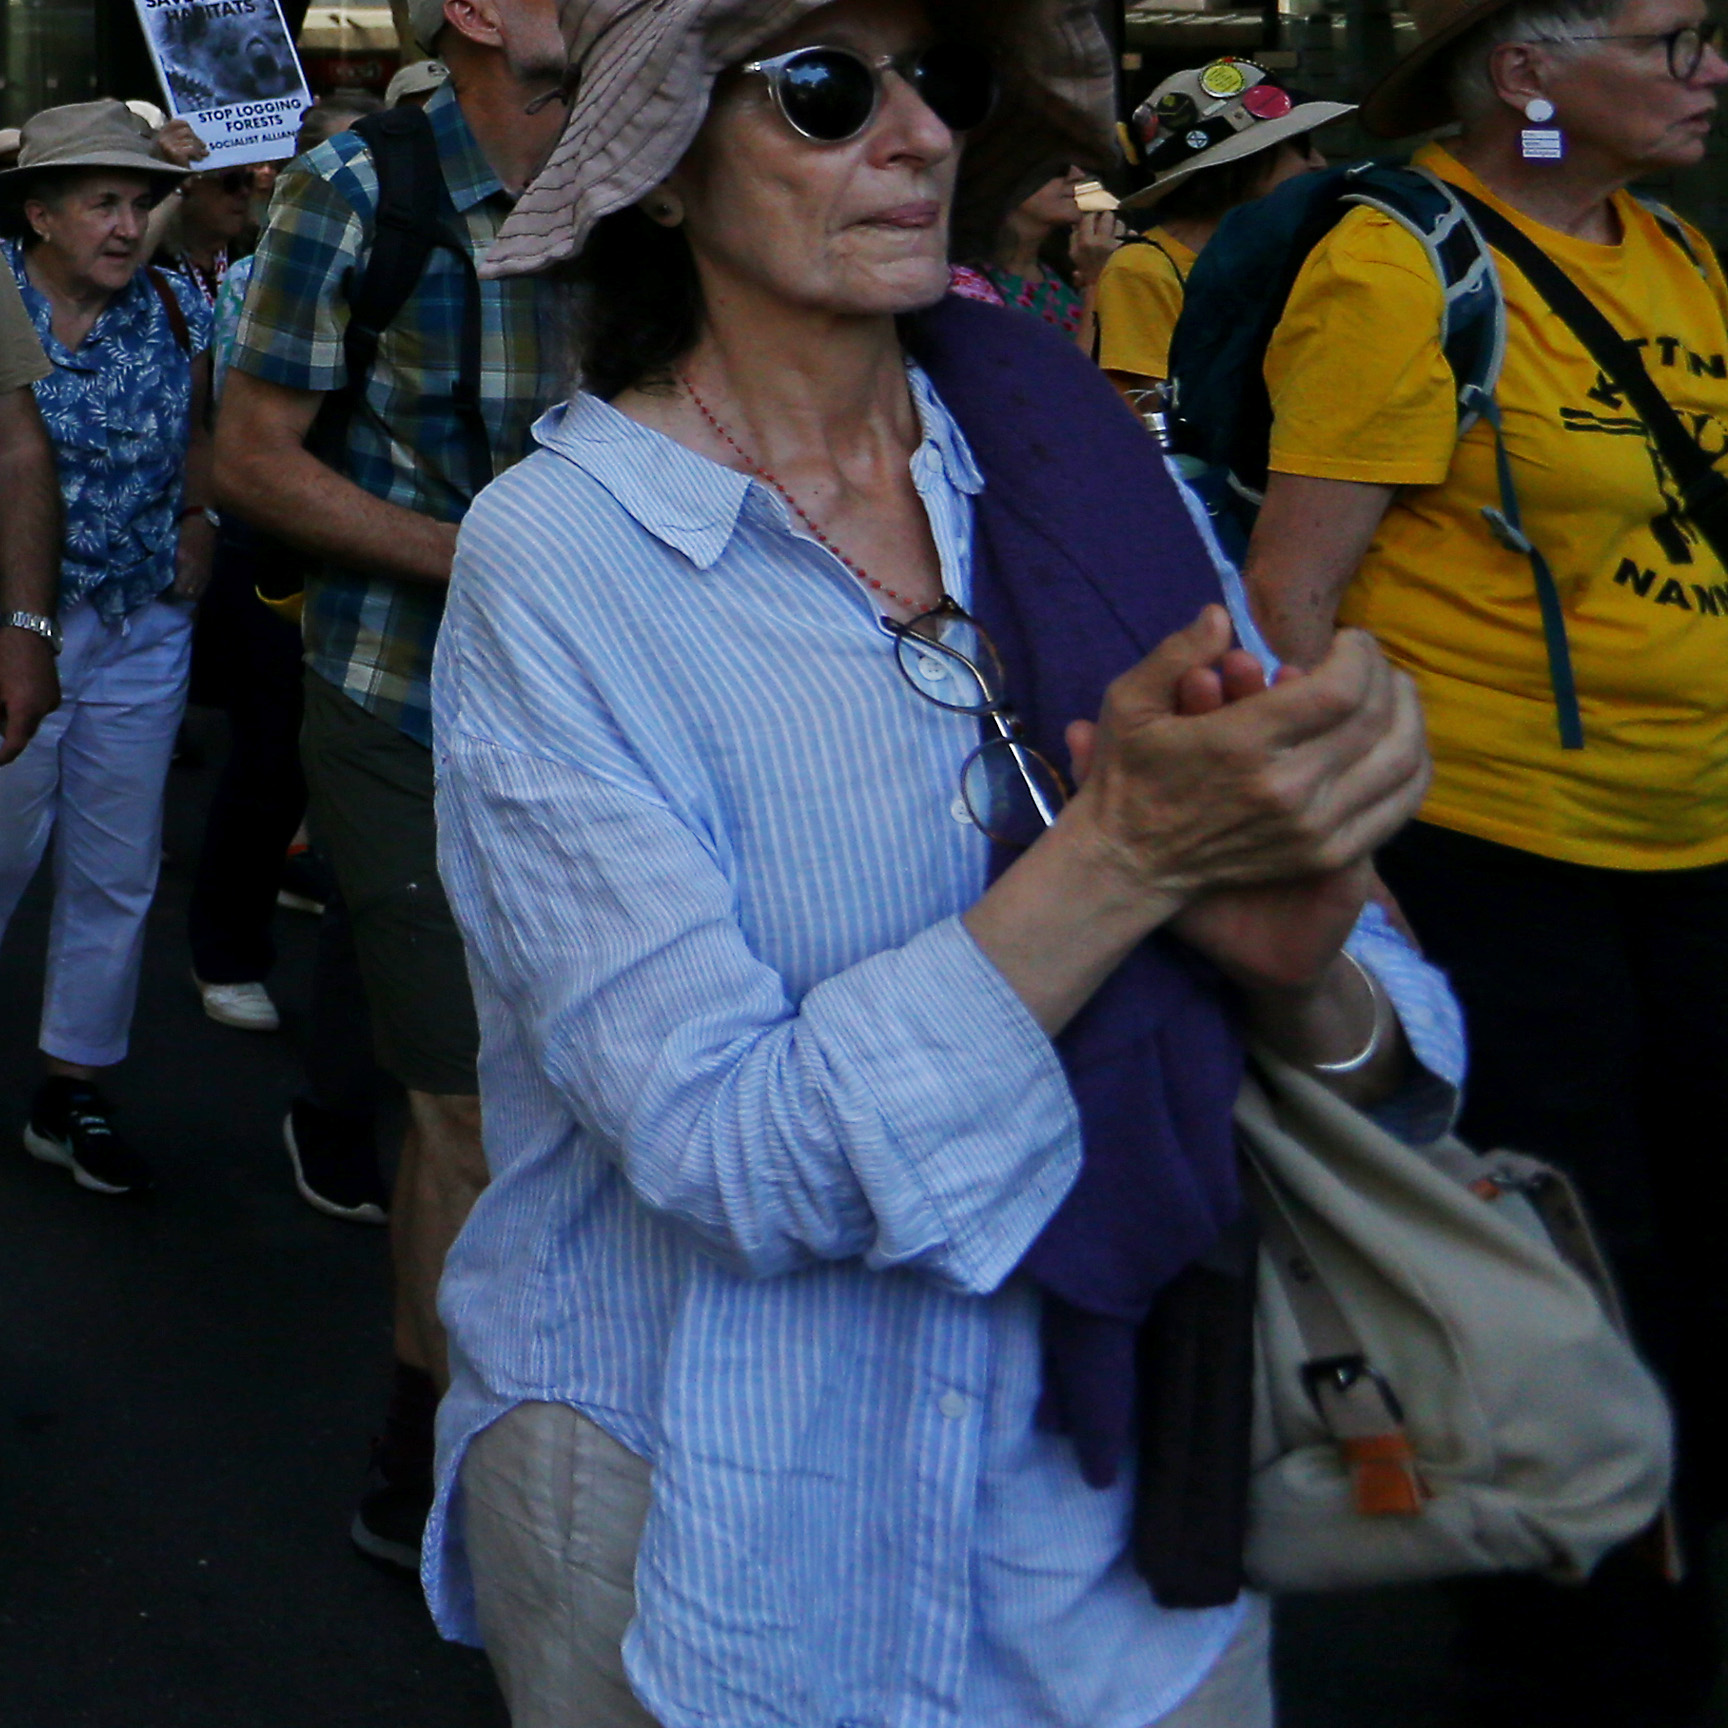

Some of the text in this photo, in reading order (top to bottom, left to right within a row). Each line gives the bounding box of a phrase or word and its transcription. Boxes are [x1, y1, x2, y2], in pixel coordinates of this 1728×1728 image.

[199, 99, 302, 123] STOP LOGGING
[226, 115, 283, 132] FORESTS
[262, 129, 298, 144] ALLIAN
